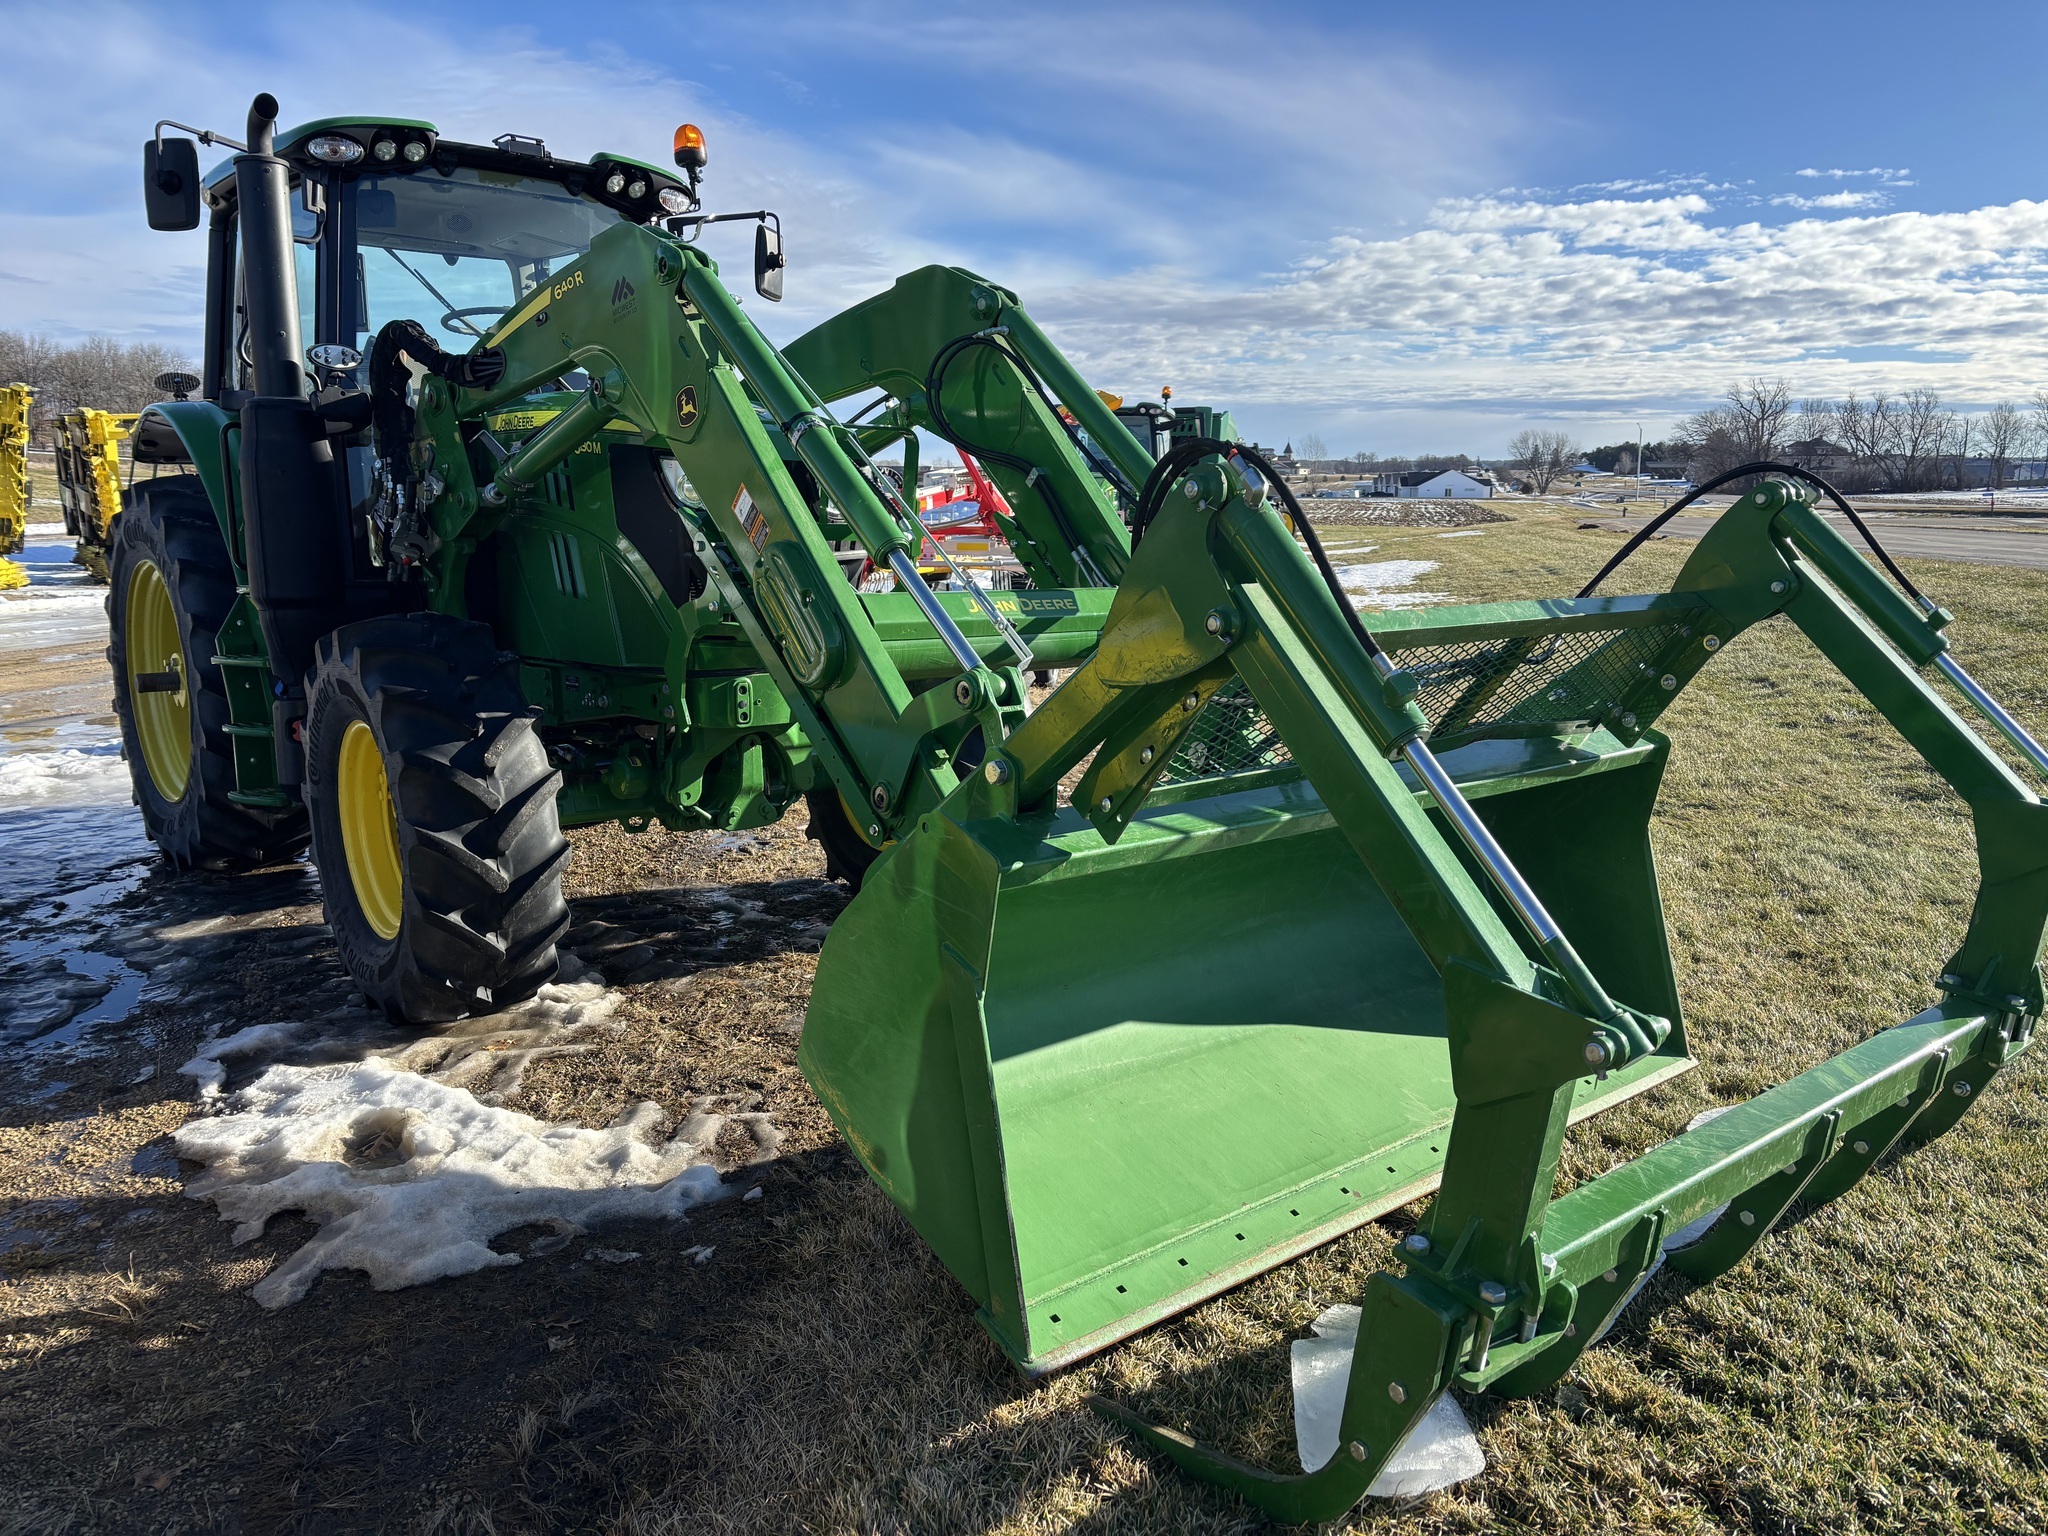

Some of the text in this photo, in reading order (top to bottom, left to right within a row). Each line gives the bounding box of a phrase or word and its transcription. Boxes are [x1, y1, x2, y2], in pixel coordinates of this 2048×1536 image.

[612, 297, 636, 316] MIDWEST
[498, 415, 534, 431] JOHN DEERE
[969, 598, 1077, 613] JHN DEERE
